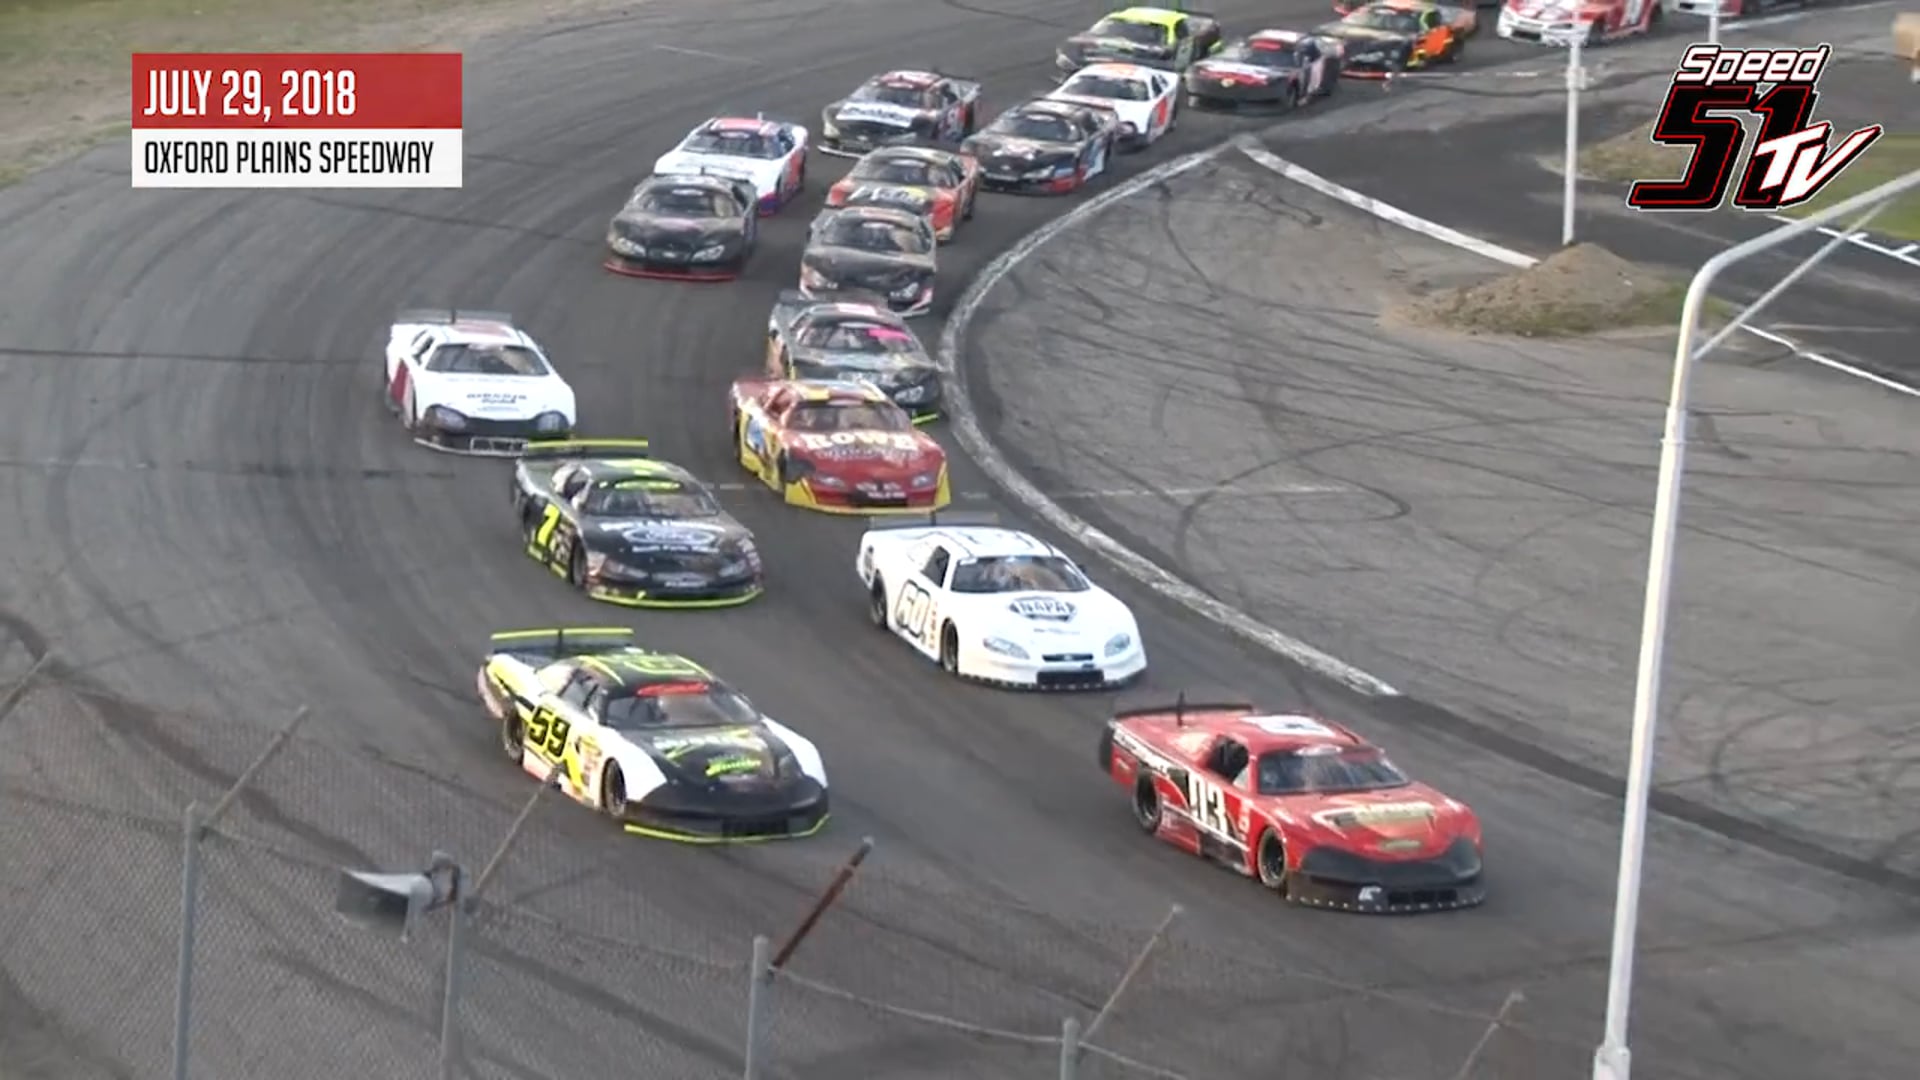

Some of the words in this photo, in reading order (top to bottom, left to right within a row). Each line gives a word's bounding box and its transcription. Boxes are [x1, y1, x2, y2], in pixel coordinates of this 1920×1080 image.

[799, 430, 919, 450] ROWE
[537, 503, 560, 547] 7
[895, 579, 931, 638] 60
[1018, 600, 1069, 614] NAPA
[528, 705, 571, 757] 59
[1188, 770, 1229, 834] 03
